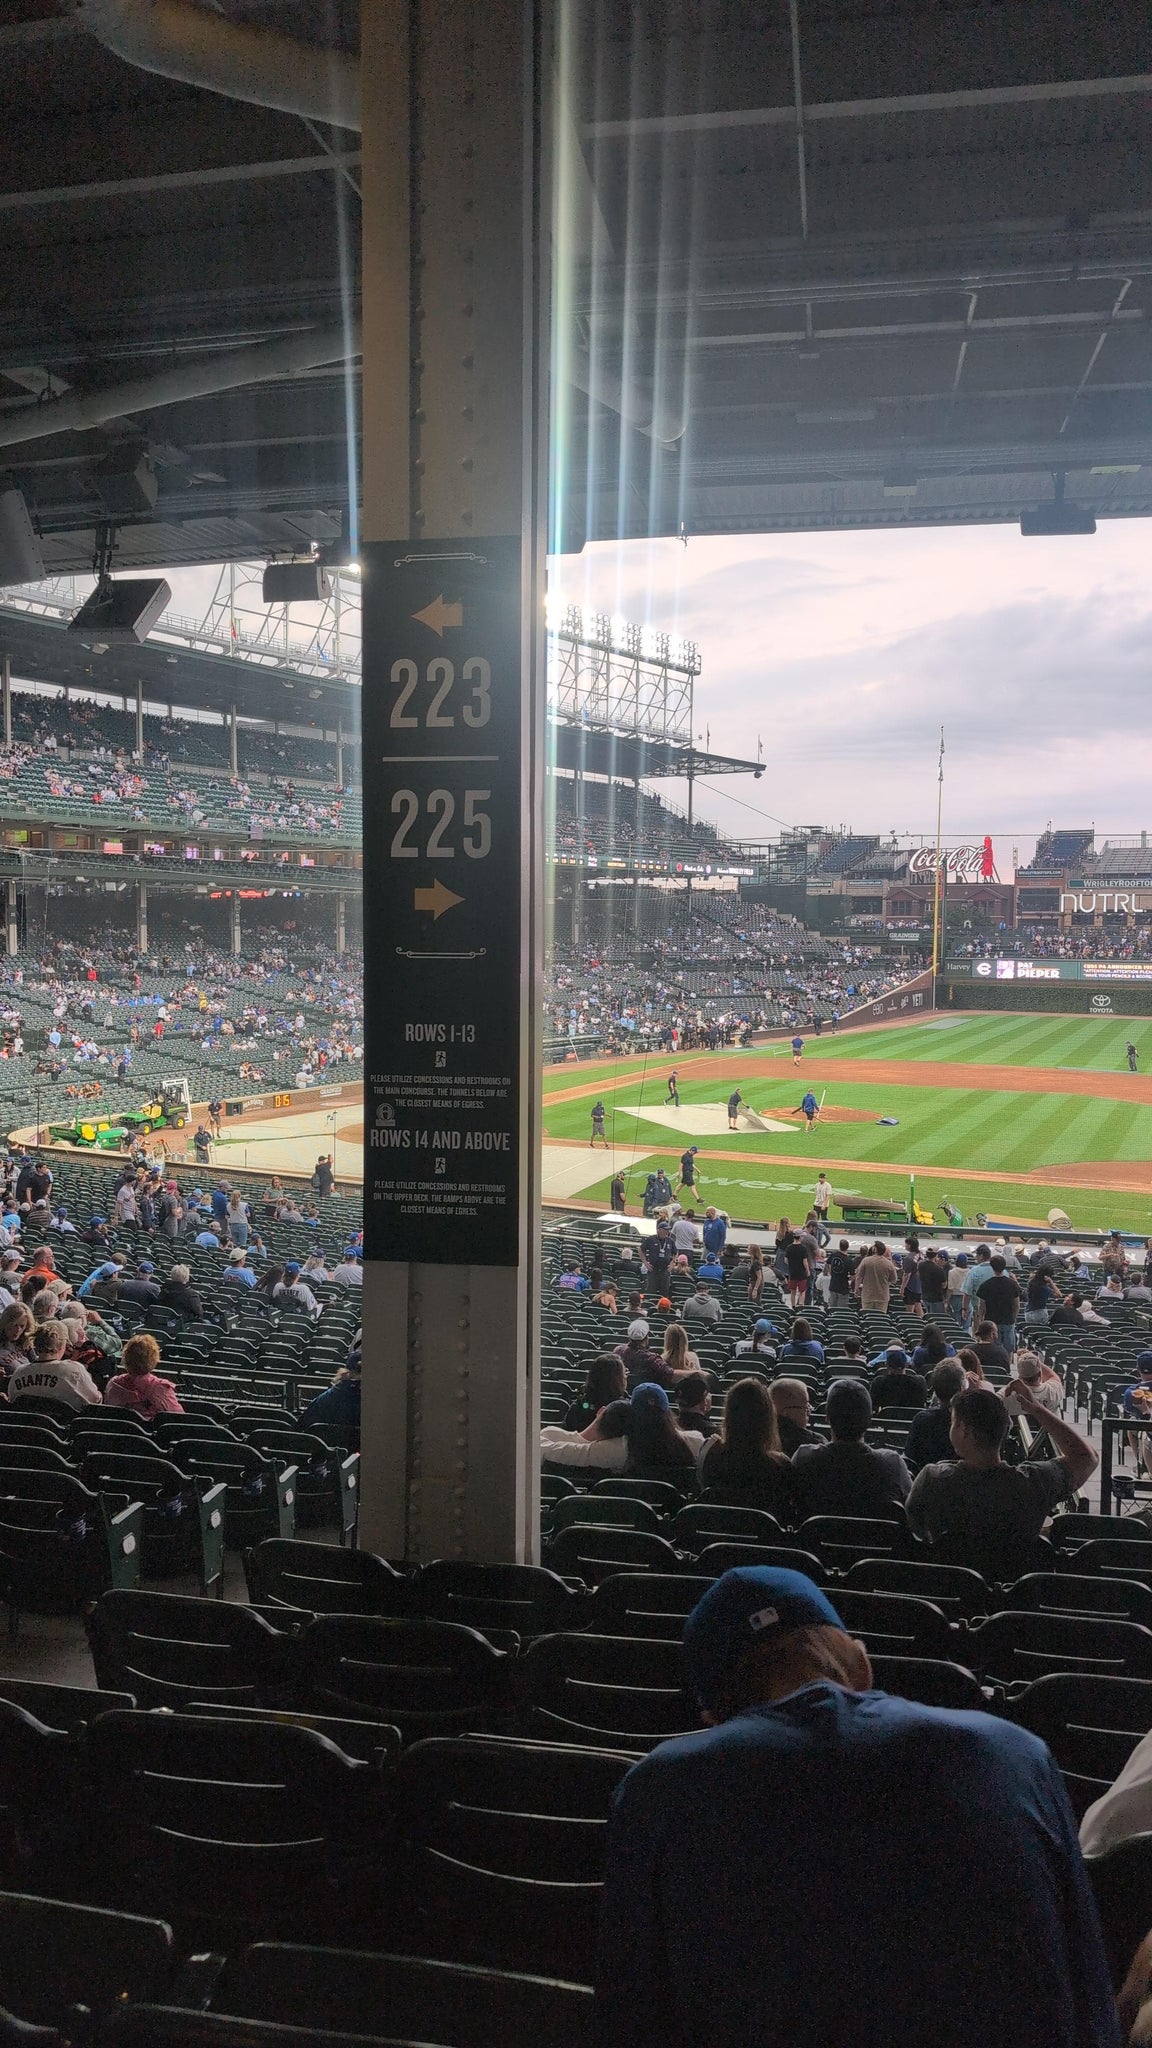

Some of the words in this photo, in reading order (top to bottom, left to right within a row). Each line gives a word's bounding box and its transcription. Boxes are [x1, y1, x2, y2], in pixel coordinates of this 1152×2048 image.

[389, 656, 492, 729] 223
[390, 788, 492, 859] 225
[909, 846, 987, 872] Coca-Cola
[947, 963, 971, 971] Harvey
[1018, 969, 1060, 978] PIEPER
[405, 1023, 446, 1042] ROWS
[450, 1024, 476, 1043] 1-13
[370, 1074, 391, 1083] PLEASE
[392, 1075, 412, 1083] UTILIZE
[413, 1075, 453, 1084] CONCESSIONS
[454, 1076, 466, 1085] AND
[467, 1076, 501, 1085] RESTROOMS
[502, 1077, 511, 1085] ON
[373, 1086, 384, 1095] THE
[385, 1087, 400, 1095] MAIN
[438, 1088, 449, 1096] THE
[449, 1088, 475, 1097] TUNNELS
[476, 1089, 495, 1097] BELOW
[496, 1089, 508, 1098] ARE
[395, 1099, 406, 1107] THE
[407, 1099, 431, 1107] CLOSEST
[432, 1099, 452, 1108] MEANS
[453, 1100, 461, 1108] OF
[462, 1100, 485, 1109] EGRESS.
[370, 1129, 411, 1148] ROWS
[415, 1130, 428, 1149] 14
[432, 1131, 461, 1150] AND
[465, 1132, 511, 1151] ABOVE
[375, 1180, 395, 1189] PLEASE
[396, 1181, 417, 1190] UTILIZE
[418, 1182, 457, 1191] CONCESSIONS
[458, 1183, 470, 1191] AND
[471, 1183, 506, 1193] RESTROOMS
[373, 1192, 382, 1200] ON
[383, 1192, 393, 1200] THE
[394, 1193, 413, 1201] UPPER
[431, 1194, 442, 1202] THE
[443, 1195, 463, 1203] RAMPS
[464, 1195, 483, 1204] ABOVE
[483, 1196, 495, 1204] ARE
[496, 1196, 506, 1205] THE
[401, 1205, 425, 1214] CLOSEST
[426, 1206, 446, 1214] MEANS
[447, 1206, 454, 1215] OF
[455, 1207, 479, 1216] EGRESS.
[15, 1374, 58, 1390] GIANTS
